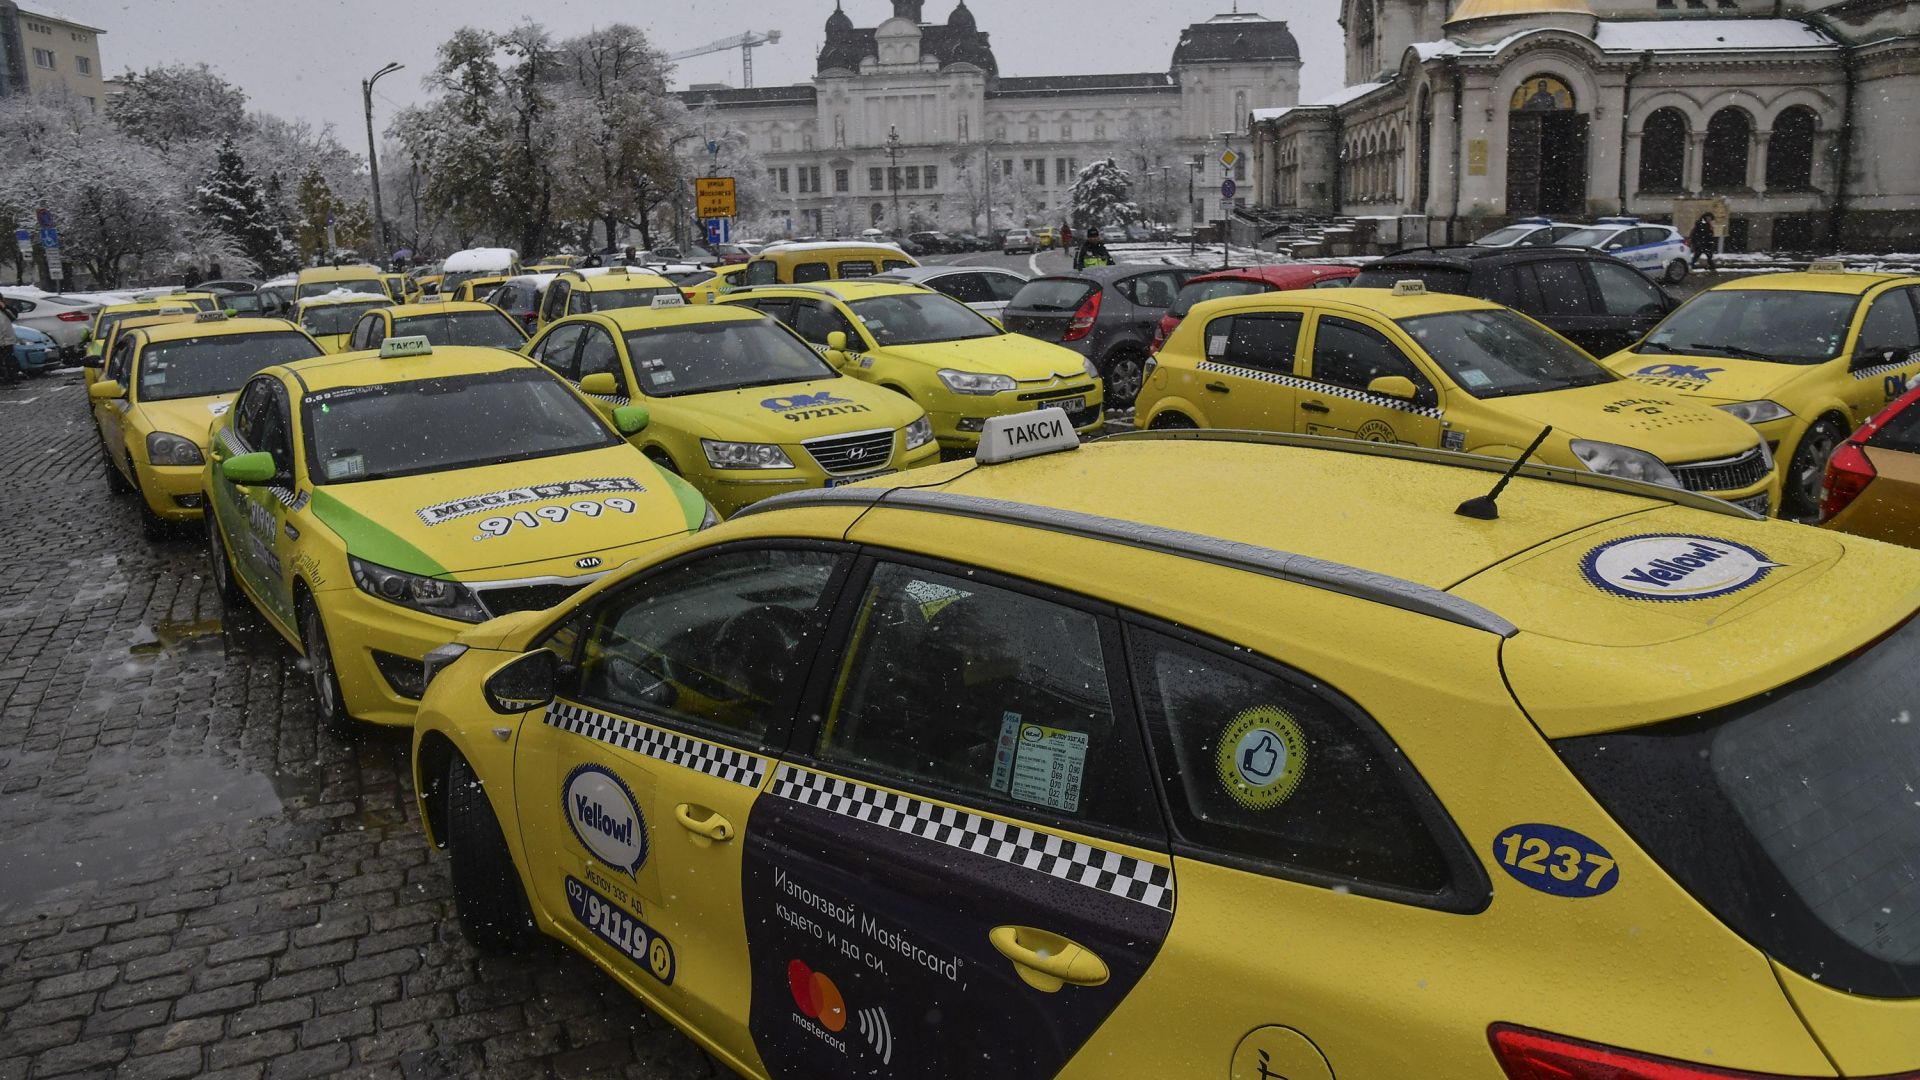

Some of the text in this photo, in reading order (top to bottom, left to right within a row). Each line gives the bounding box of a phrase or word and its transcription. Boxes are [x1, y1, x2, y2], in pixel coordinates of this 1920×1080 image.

[657, 298, 681, 306] ТАКСИ
[1401, 284, 1423, 292] ТАКСИ
[390, 340, 423, 352] ТАКСИ
[1637, 363, 1726, 383] OK
[784, 404, 872, 423] 9722121
[1003, 419, 1064, 447] ТАКСИ
[433, 479, 637, 519] MEGA TAXI
[478, 497, 637, 536] 91999
[579, 557, 600, 568] KIA
[1621, 541, 1729, 588] Yellow!
[1230, 716, 1297, 758] ТАКСИ ЗА ПРИМЕР
[1228, 770, 1283, 798] MOEL TAXI
[575, 793, 634, 847] Yellow!
[1502, 833, 1615, 889] 1237
[775, 866, 856, 929] Използвай
[775, 902, 889, 977] където и да си.
[792, 1012, 847, 1054] mastercard
